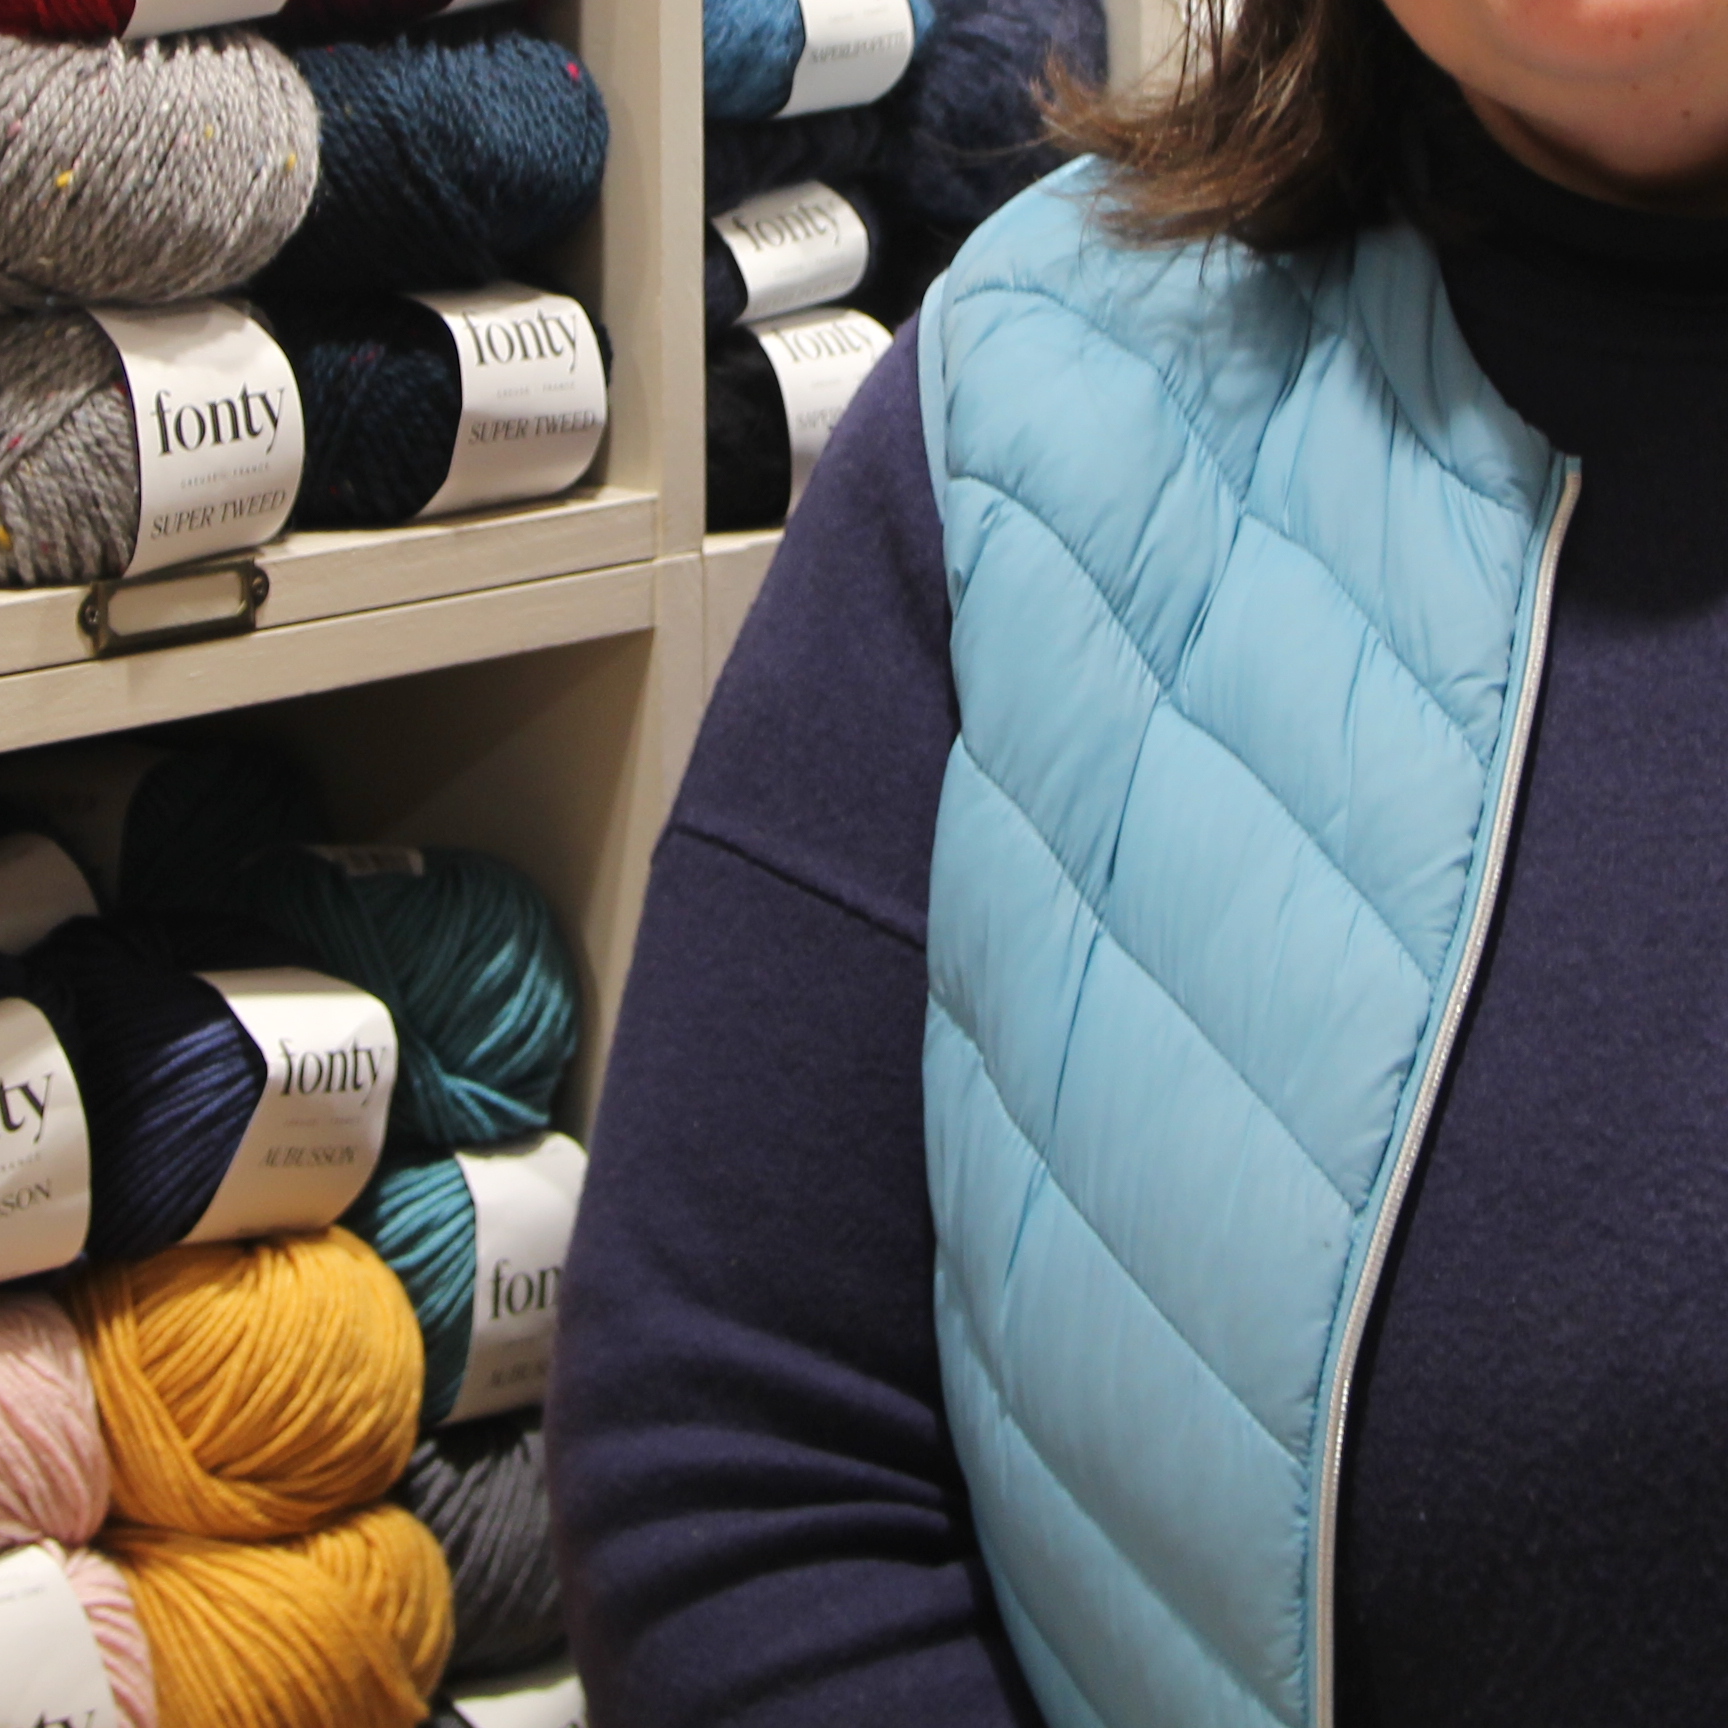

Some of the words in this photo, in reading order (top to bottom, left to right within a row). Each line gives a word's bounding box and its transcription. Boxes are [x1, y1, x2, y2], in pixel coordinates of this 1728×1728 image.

[462, 307, 578, 373] fonty
[151, 381, 286, 456] fonty
[468, 416, 528, 445] SUPER
[534, 410, 596, 440] TWEED
[151, 505, 215, 540] SUPER
[220, 489, 286, 525] TWEED
[278, 1037, 387, 1106] fonty
